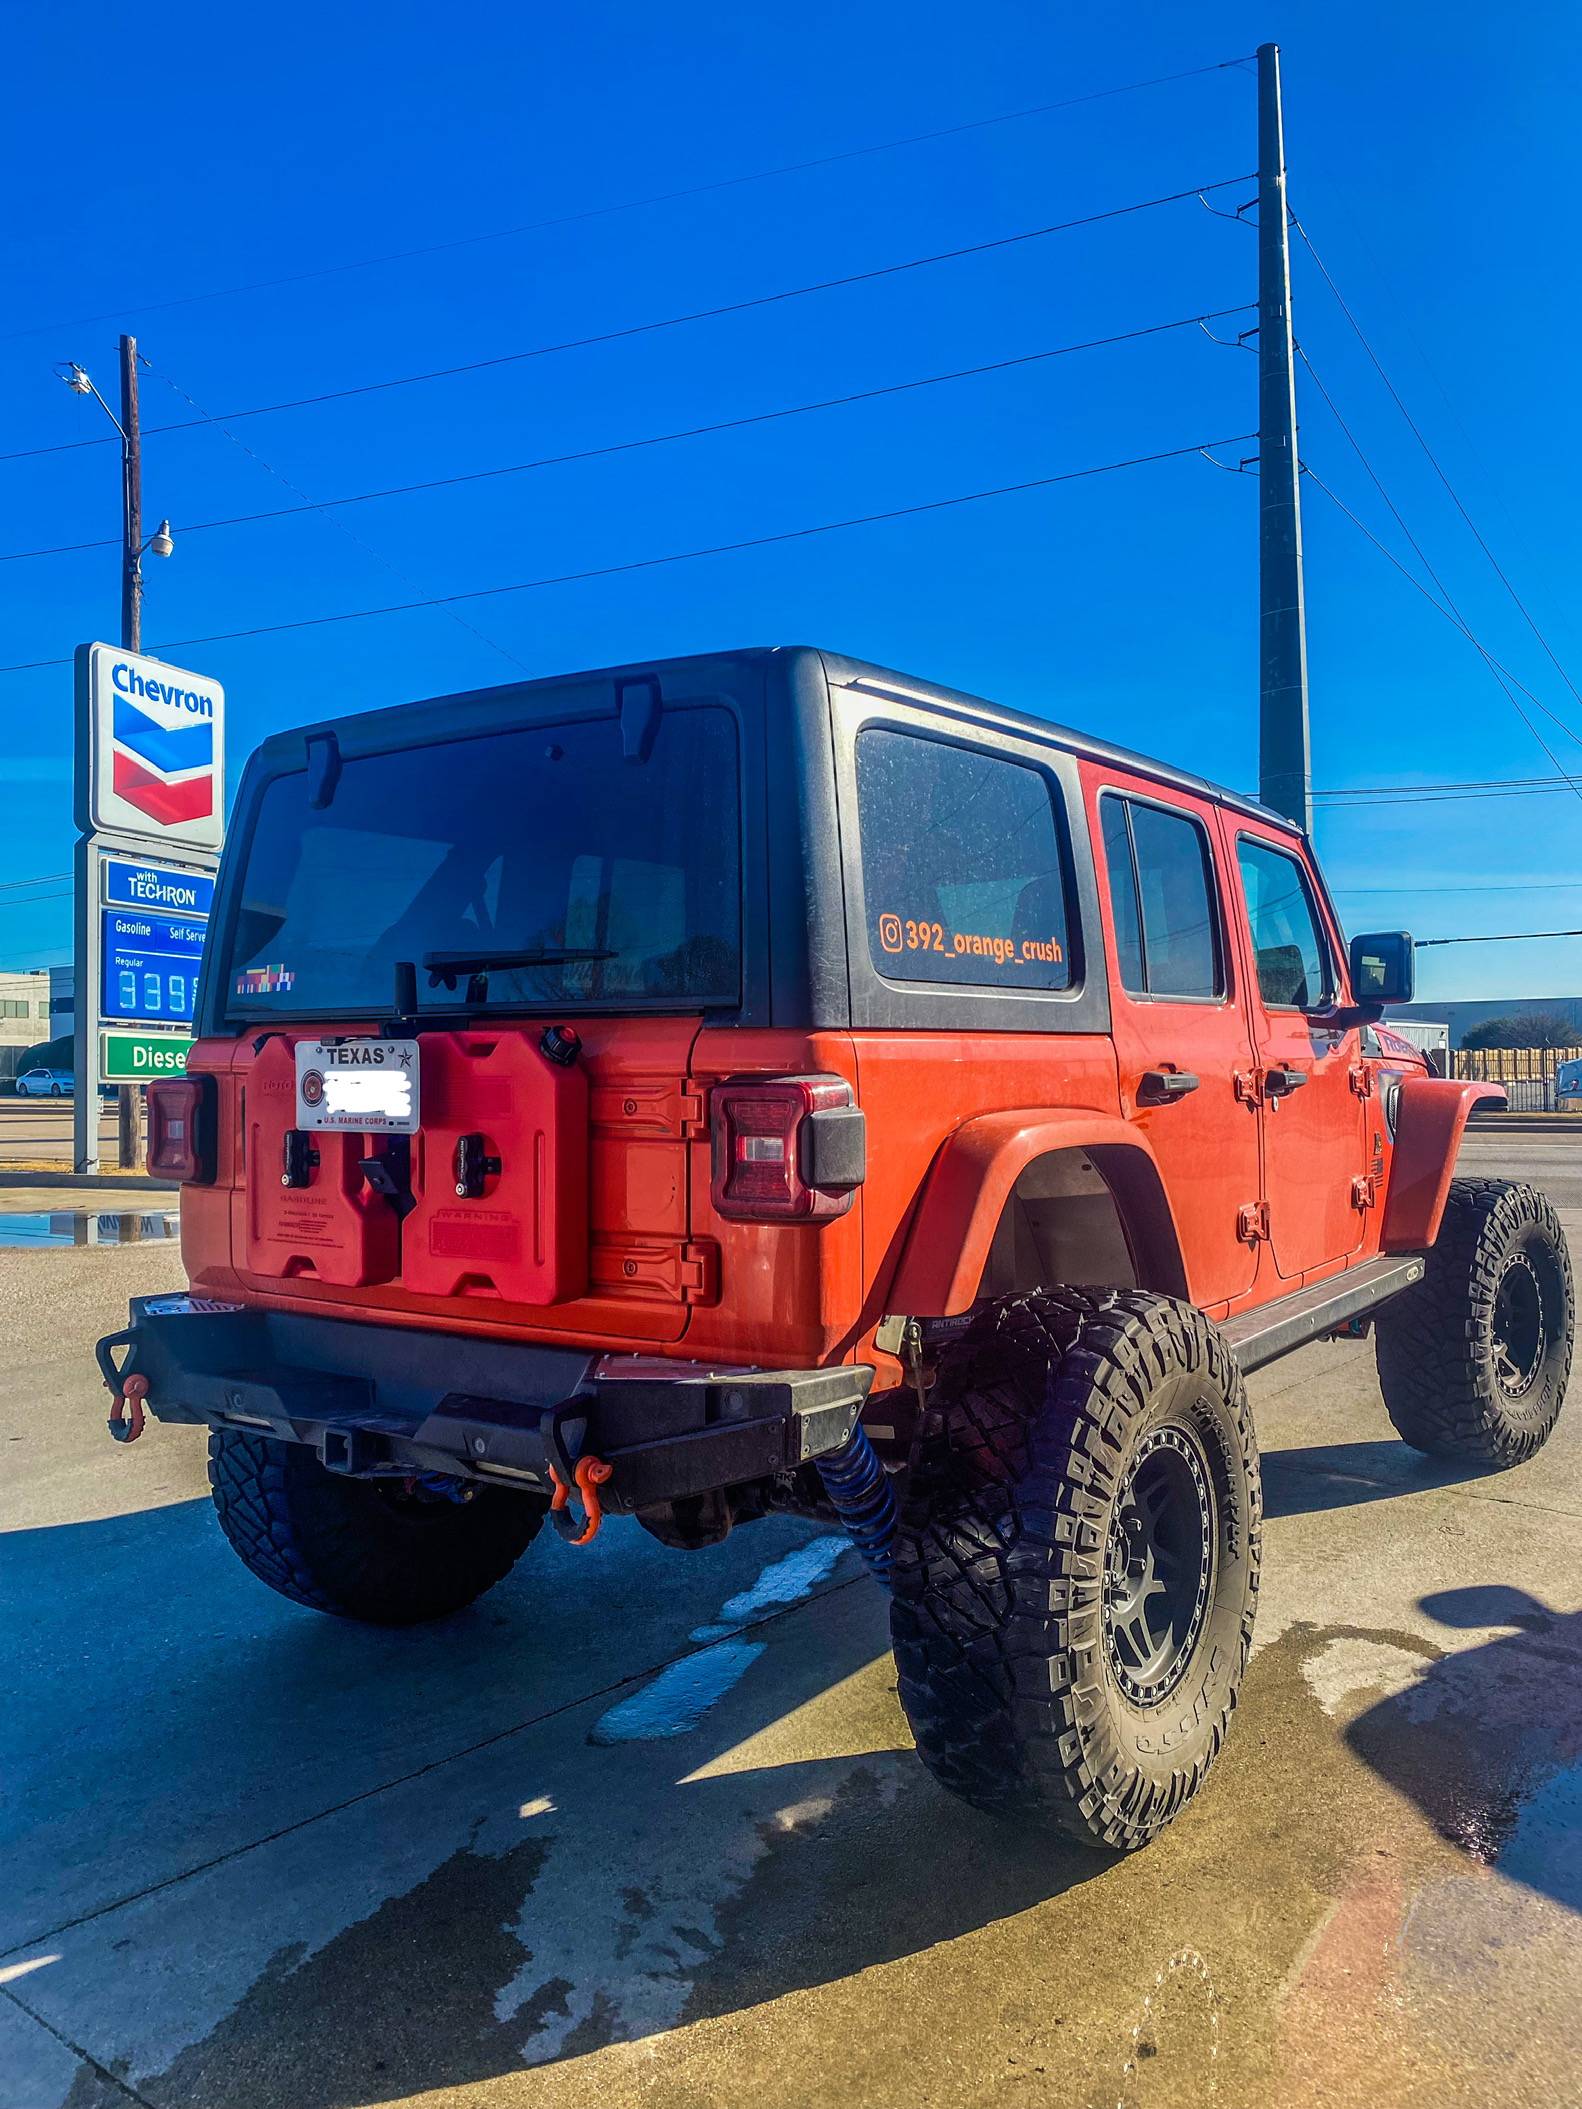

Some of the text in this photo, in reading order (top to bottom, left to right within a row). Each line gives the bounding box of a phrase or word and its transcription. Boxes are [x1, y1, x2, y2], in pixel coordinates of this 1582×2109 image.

[111, 662, 213, 718] Chevron
[136, 871, 158, 883] with
[128, 876, 195, 907] TECHRON
[115, 919, 206, 943] Gasoline Self Serve
[906, 920, 1063, 965] 392_orange_crush
[115, 956, 144, 968] Regular
[133, 1045, 190, 1069] Diese
[326, 1047, 385, 1065] TEXAS
[323, 1116, 337, 1124] U.S.
[338, 1116, 364, 1125] MARINE
[365, 1117, 387, 1126] CORPS
